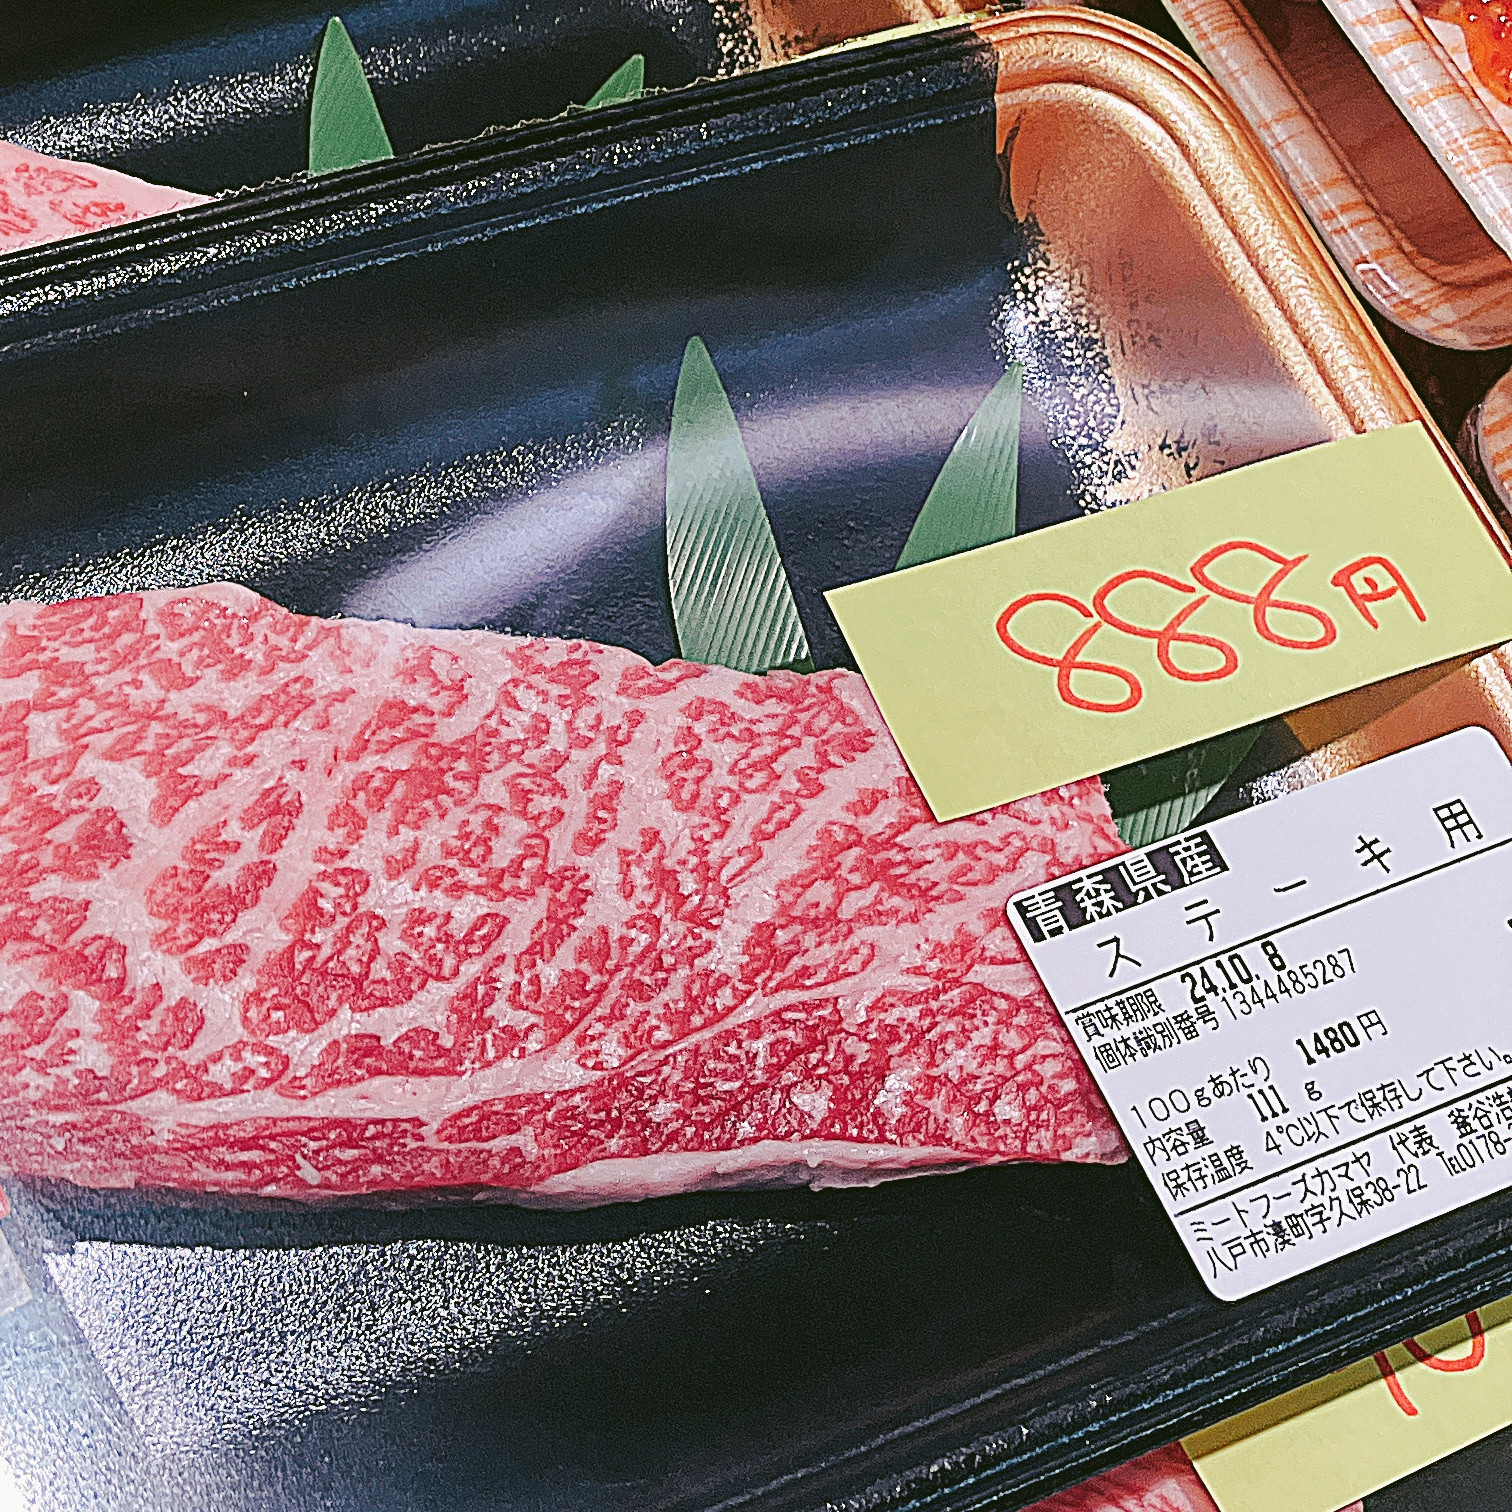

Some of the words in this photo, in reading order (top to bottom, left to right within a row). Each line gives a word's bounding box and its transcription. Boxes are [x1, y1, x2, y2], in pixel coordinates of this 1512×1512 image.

[1021, 835, 1224, 942] 青森県産
[1074, 988, 1166, 1043] 賞味期限
[1092, 1003, 1220, 1074] 個体識別番号
[1220, 947, 1357, 1021] 1344485287
[1130, 1055, 1271, 1129] 100gあたり
[1142, 1117, 1215, 1168] 内容量
[1246, 1084, 1290, 1123] 111
[1160, 1144, 1255, 1202] 保存温度
[1189, 1150, 1373, 1242] ミートフーズカマヤ
[1388, 1124, 1440, 1165] 代表
[1447, 1086, 1512, 1140] 釜谷浩
[1205, 1163, 1429, 1280] 八戸市湊町字久保38-22
